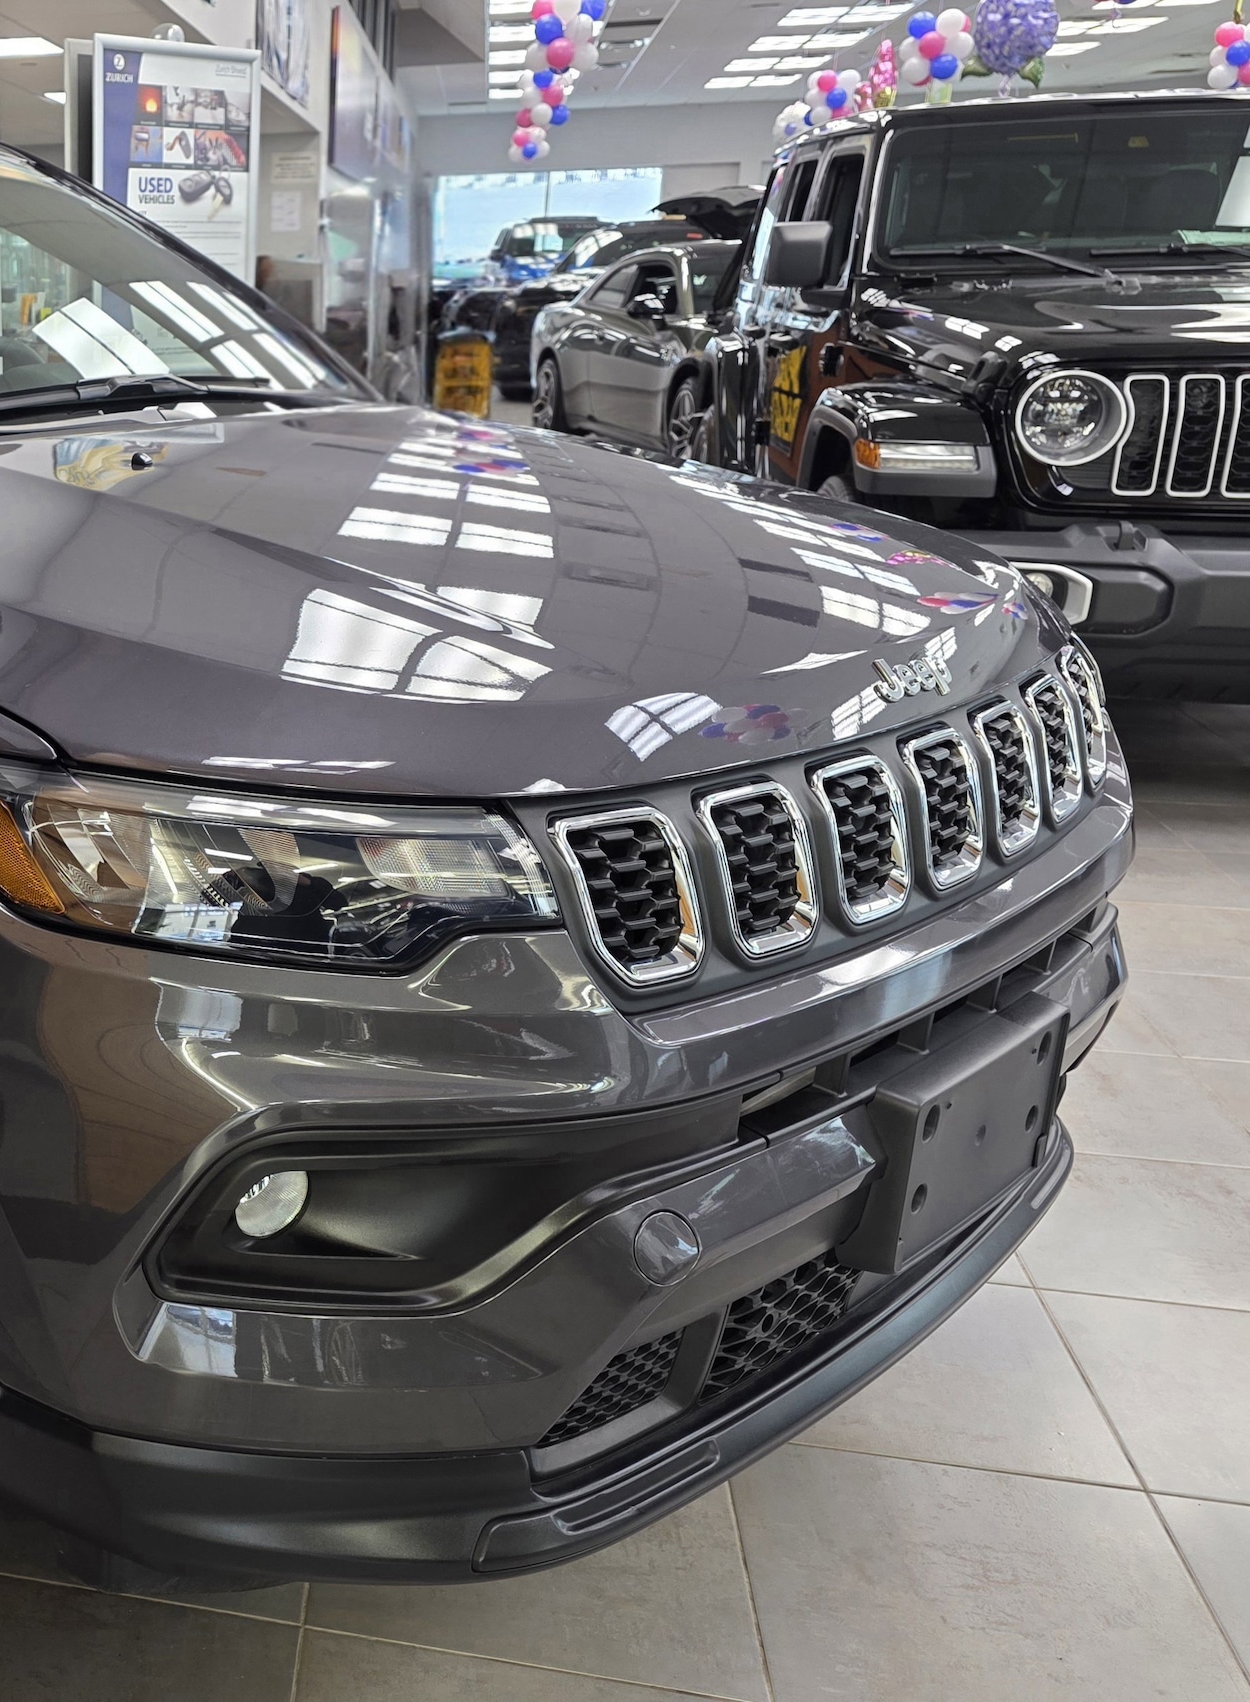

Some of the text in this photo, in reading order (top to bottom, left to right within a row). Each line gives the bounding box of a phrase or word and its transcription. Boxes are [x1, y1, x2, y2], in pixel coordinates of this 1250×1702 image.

[105, 72, 134, 83] ZURICH
[138, 176, 173, 193] USED
[138, 194, 175, 205] VEHICLES
[872, 657, 953, 703] Jeep
